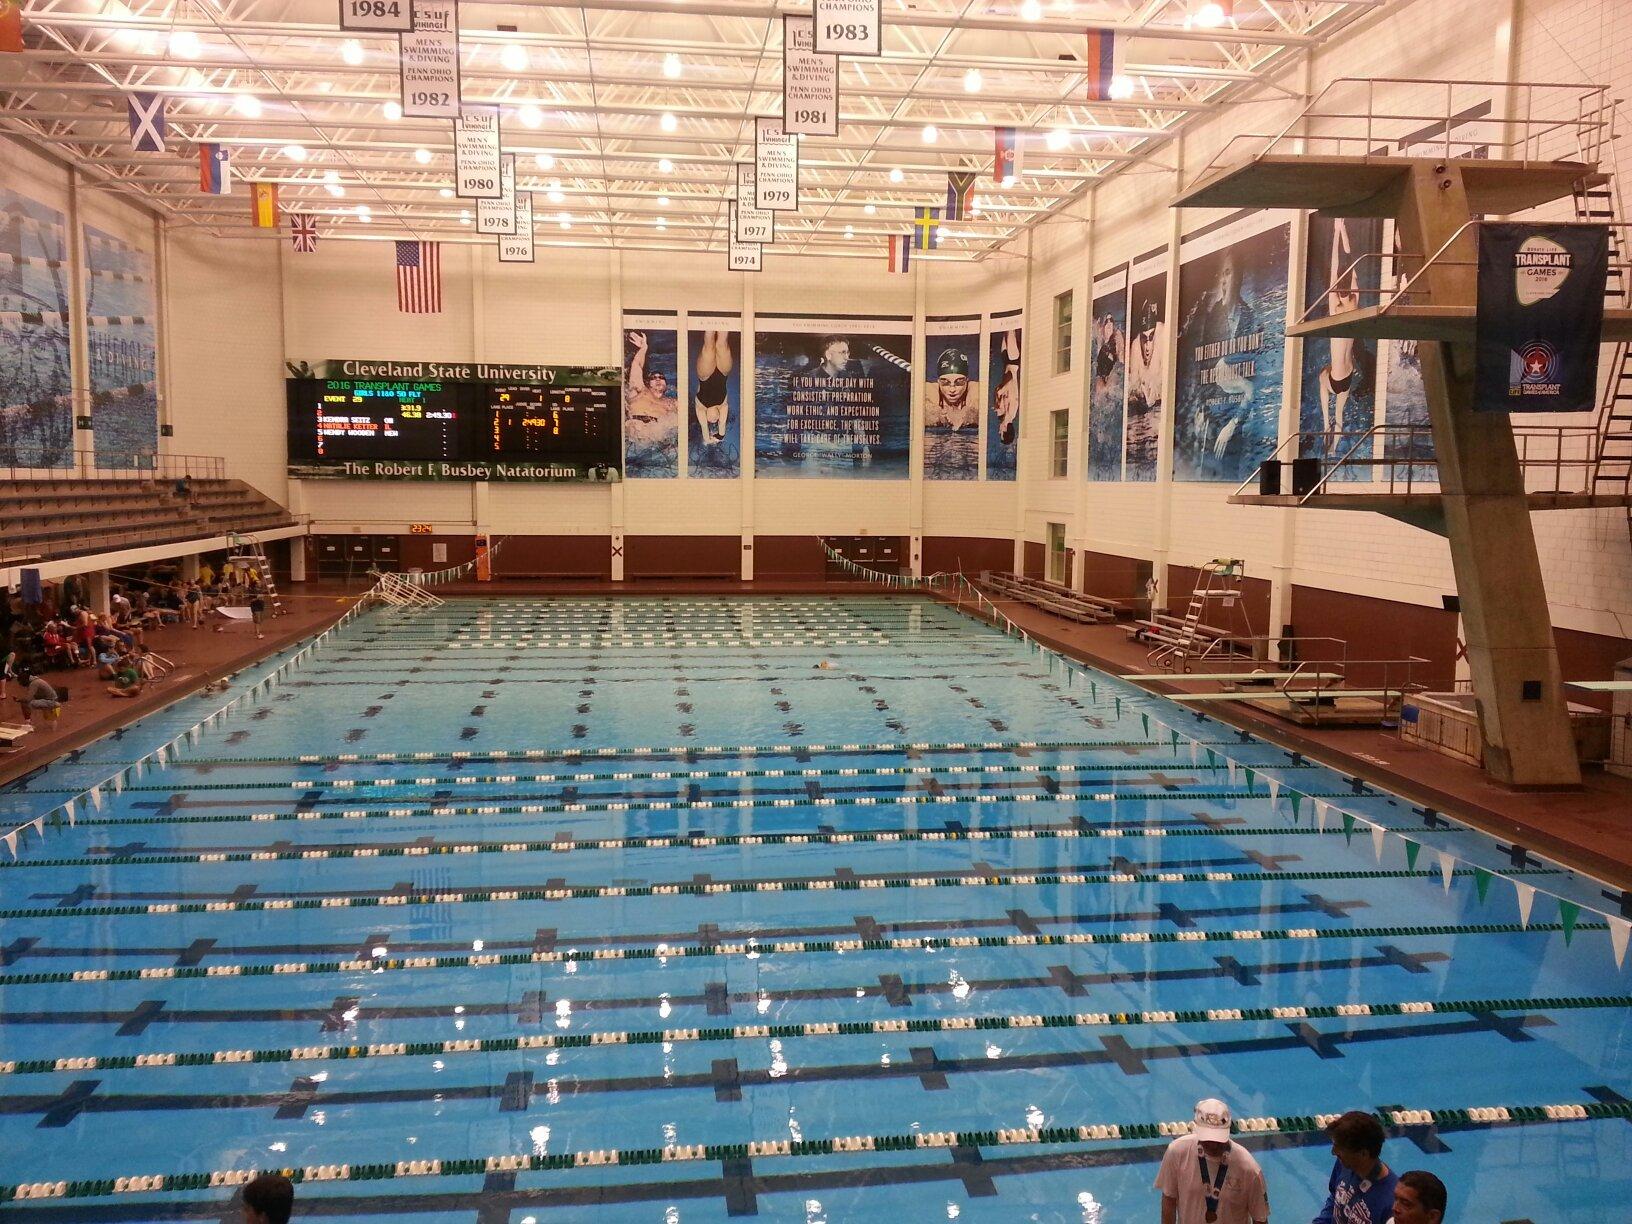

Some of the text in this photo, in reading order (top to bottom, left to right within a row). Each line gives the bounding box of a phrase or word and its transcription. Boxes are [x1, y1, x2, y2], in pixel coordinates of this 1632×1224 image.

[351, 1, 401, 17] 1984
[819, 3, 875, 12] CHAMPIONS
[826, 24, 869, 40] 1983
[404, 47, 454, 55] SWIMMING
[417, 55, 450, 63] DIVING
[787, 66, 835, 74] SWIMMING
[800, 74, 830, 82] DIVING
[411, 92, 450, 107] 1982
[795, 110, 826, 124] 1981
[464, 179, 494, 190] 1980
[763, 191, 790, 202] 1979
[484, 218, 509, 228] 1978
[744, 227, 766, 236] 1977
[505, 247, 528, 256] 1976
[735, 256, 755, 265] 1974
[1515, 254, 1571, 266] TRANSPLANT
[1527, 268, 1557, 276] GAMES
[1204, 342, 1221, 360] EITHER
[108, 351, 148, 371] DIVING
[343, 361, 557, 384] Cleveland State University
[1200, 369, 1210, 386] THE
[327, 381, 442, 391] 2016 TRANSPLANT GAMES
[793, 377, 874, 388] IF YOU WIN EACH DAY WITH
[792, 391, 830, 402] CONSISTENT
[786, 405, 804, 416] WORK
[827, 406, 839, 416] AND
[840, 406, 880, 417] EXPECTATION
[787, 420, 799, 430] FOR
[841, 420, 853, 431] THE
[854, 420, 879, 431] RESULTS
[783, 433, 799, 444] WILL
[800, 434, 815, 444] TAKE
[816, 434, 832, 444] CARE
[833, 434, 841, 444] OF
[344, 462, 577, 480] The Robert F. Busbey Natatorium
